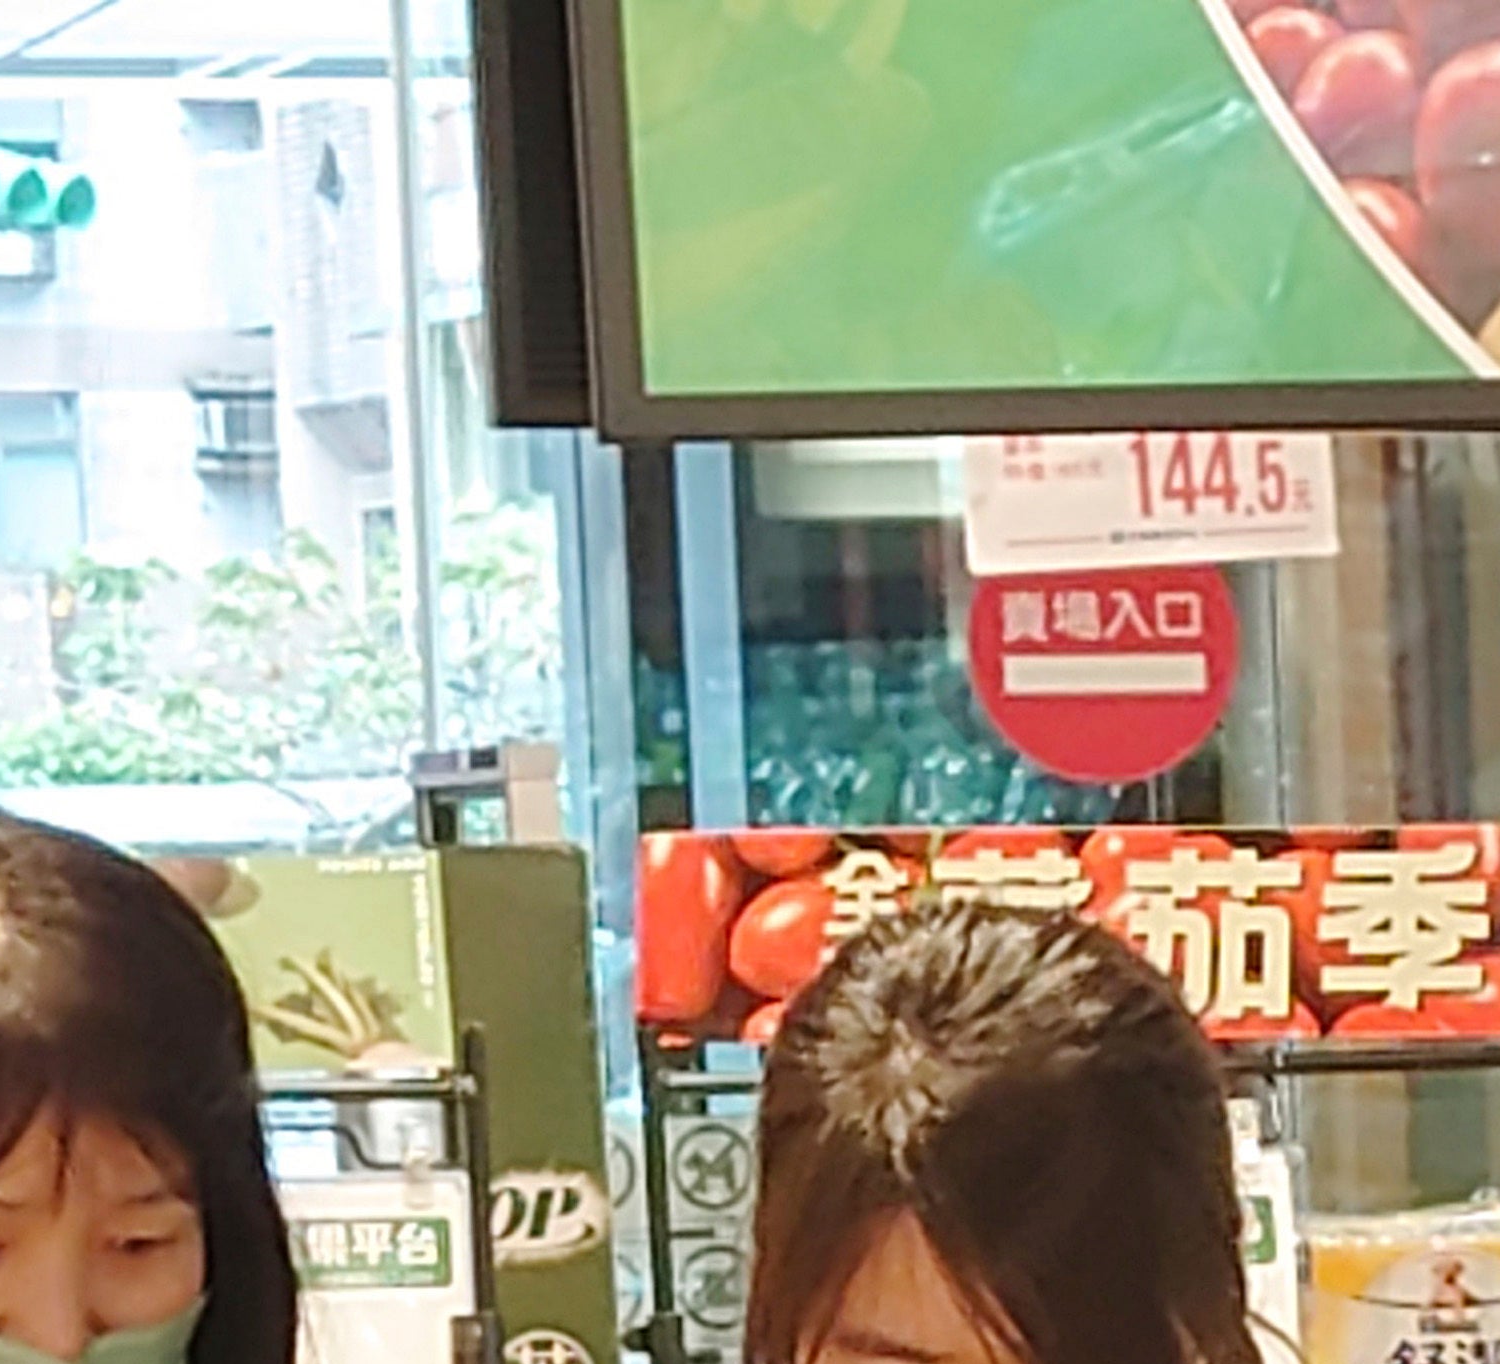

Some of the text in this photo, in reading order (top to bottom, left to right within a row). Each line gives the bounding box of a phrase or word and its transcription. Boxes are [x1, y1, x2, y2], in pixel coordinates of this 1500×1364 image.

[1127, 432, 1288, 518] 144.5
[1000, 589, 1204, 644] 賣場入口
